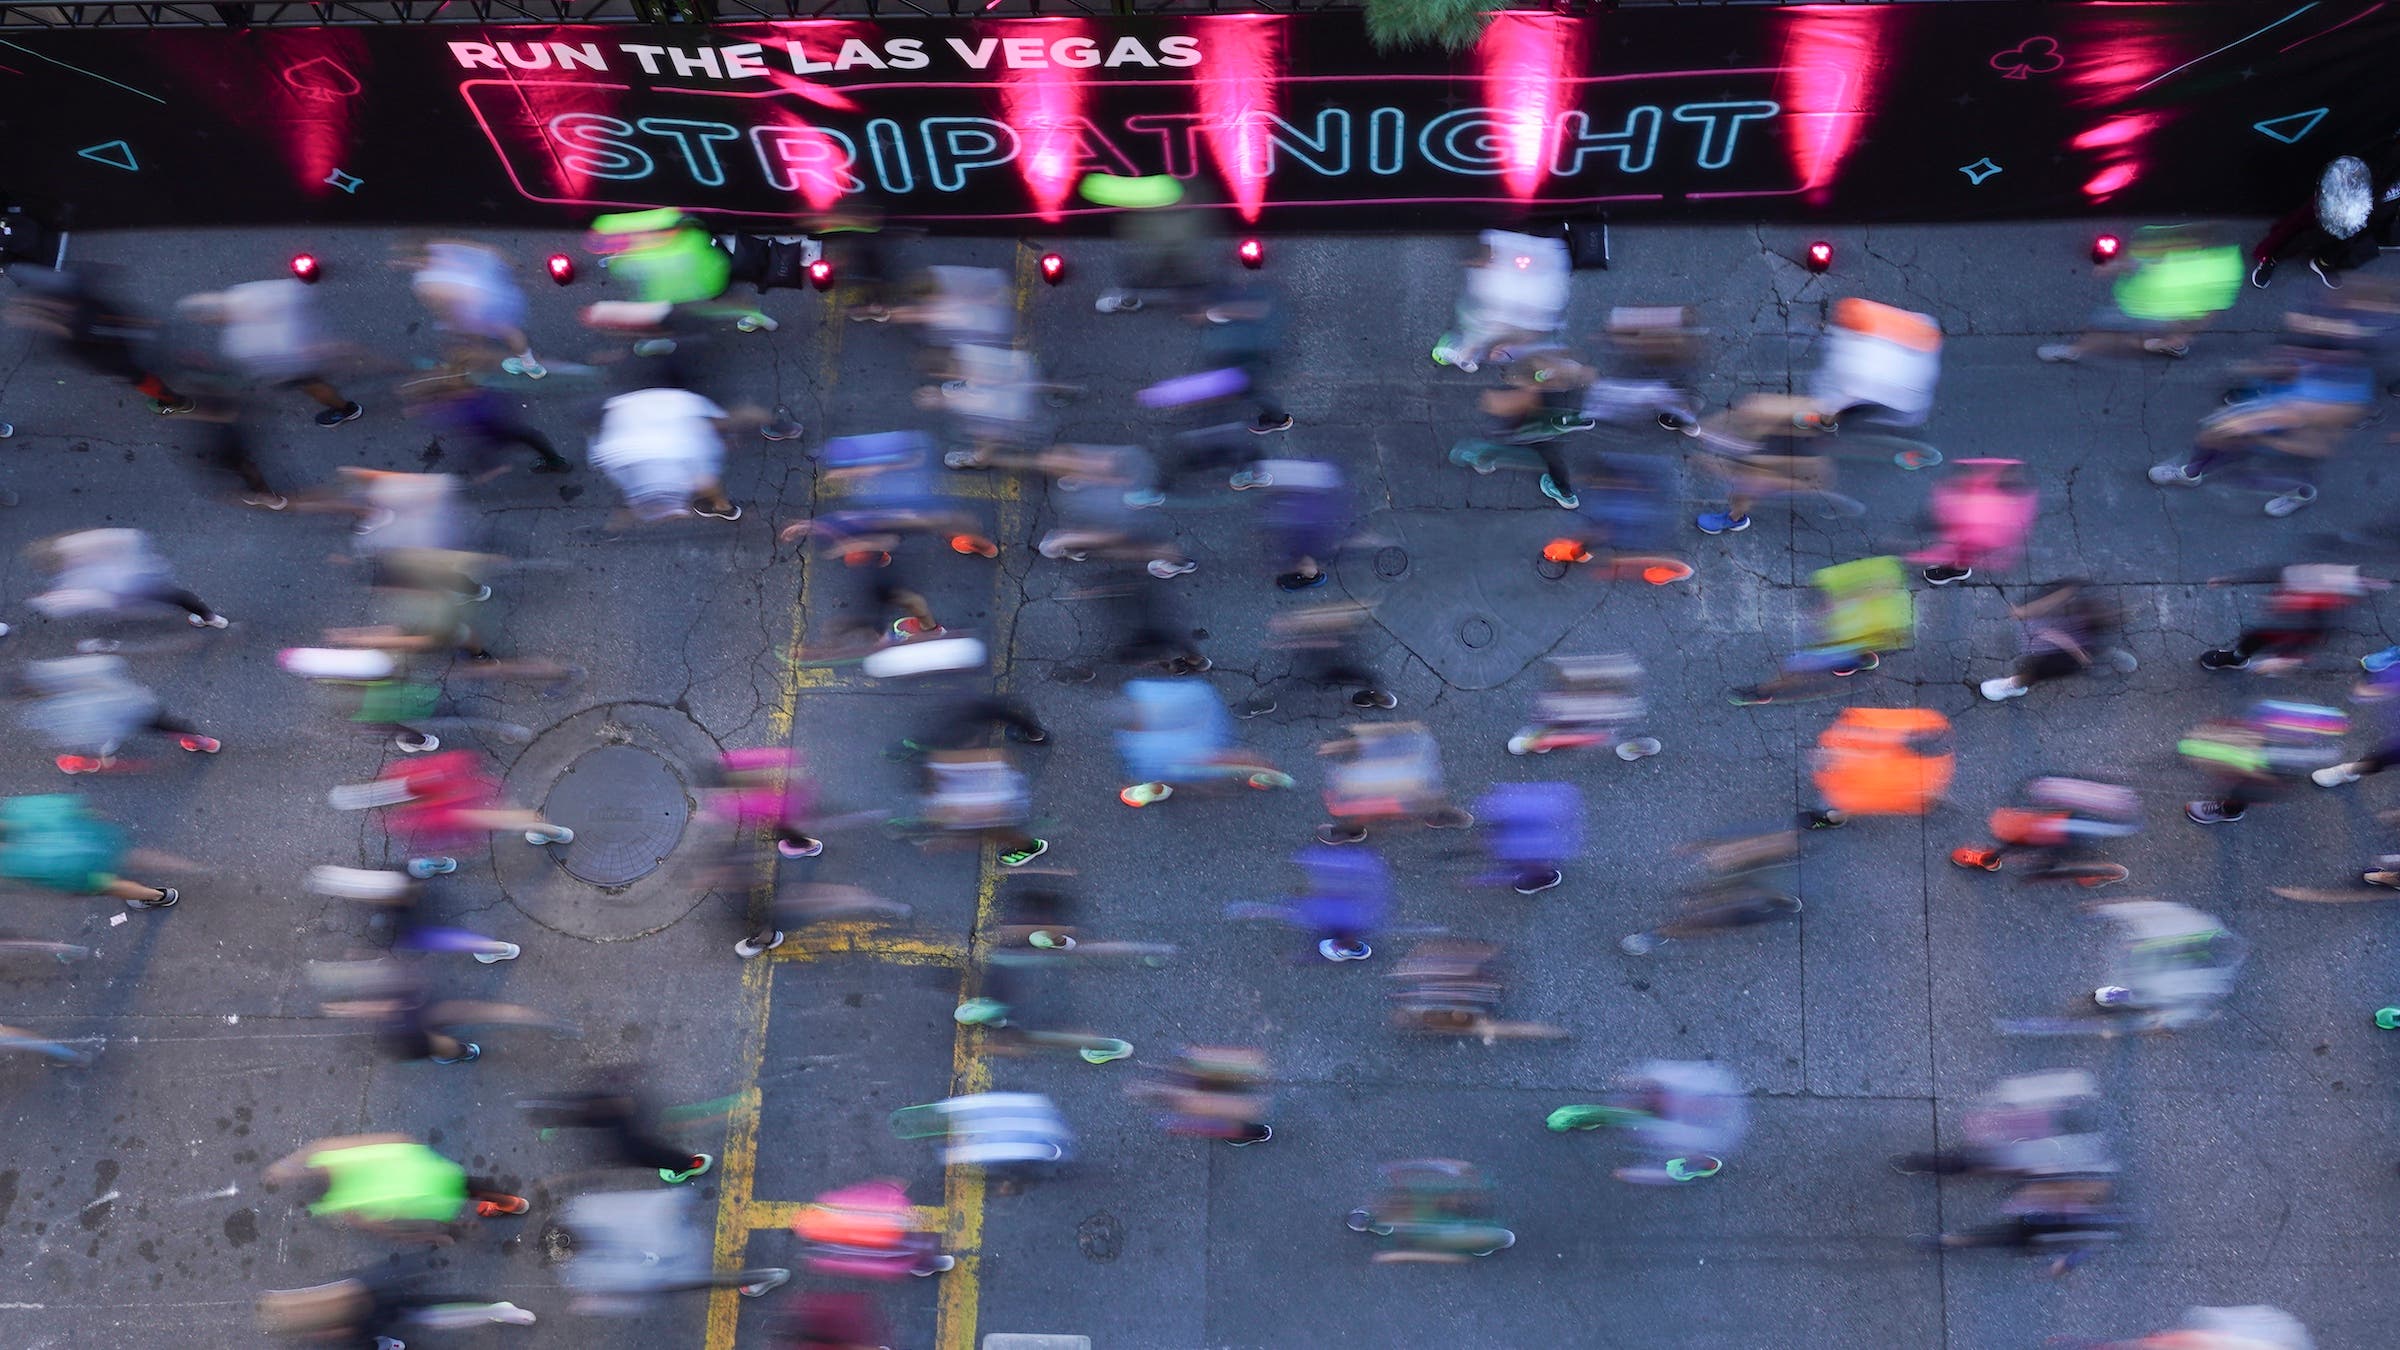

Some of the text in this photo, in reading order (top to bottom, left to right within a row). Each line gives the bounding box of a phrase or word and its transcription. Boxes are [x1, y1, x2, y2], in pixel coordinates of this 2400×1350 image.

[447, 35, 1203, 79] RUN THE LAS VEGAS
[549, 112, 1022, 193] STRIP
[1236, 101, 1781, 178] NIGHT
